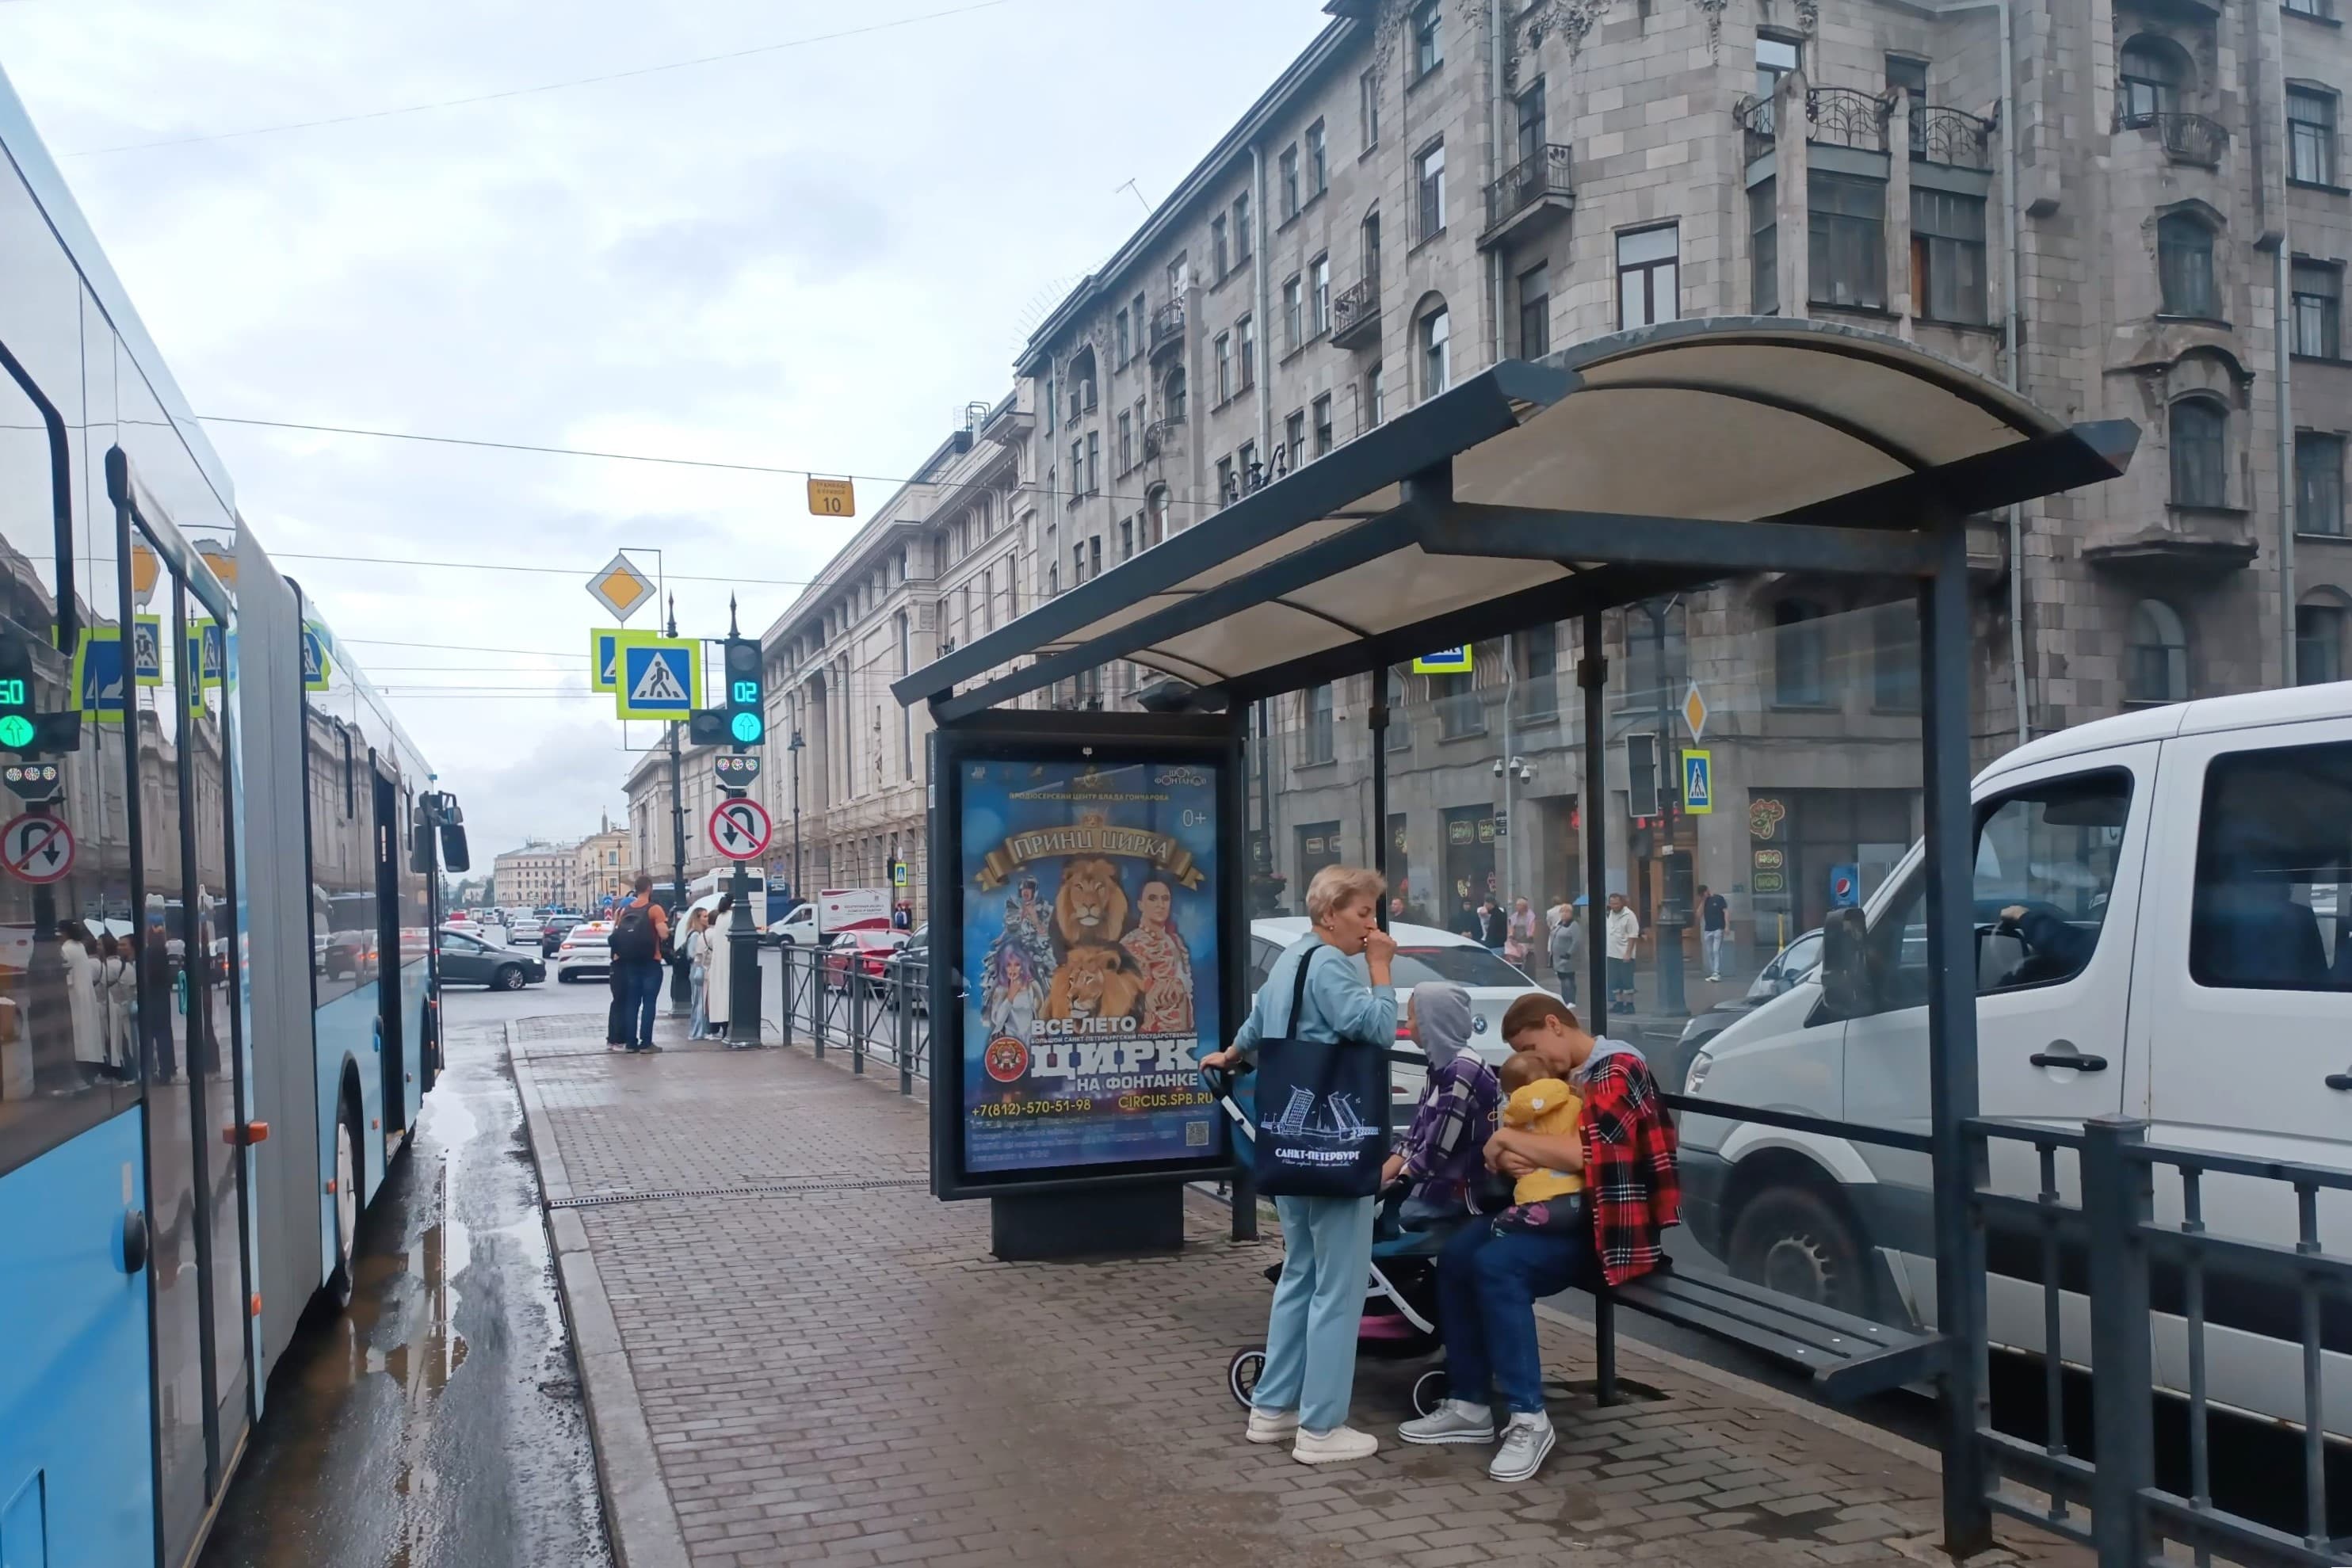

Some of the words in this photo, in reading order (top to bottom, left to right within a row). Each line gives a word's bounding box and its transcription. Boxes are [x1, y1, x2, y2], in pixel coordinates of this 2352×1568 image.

[823, 497, 841, 513] 10
[734, 681, 757, 703] 02
[1182, 808, 1206, 827] 0+
[1014, 830, 1093, 859] ПРИНЦ
[1102, 830, 1168, 859] ЦИРКА
[1031, 1018, 1074, 1035] ВСЕ
[1080, 1016, 1136, 1033] ЛЕТО
[1031, 1038, 1198, 1080] ЦИРК
[1077, 1078, 1100, 1092] НА
[1105, 1073, 1198, 1089] ФОНТАНКЕ
[972, 1099, 1091, 1117] +7(812)-570-51-98
[1118, 1093, 1213, 1108] CIRCUS.SPB.RU
[1274, 1148, 1361, 1162] САНКТ-ПЕТЕРБУРГ
